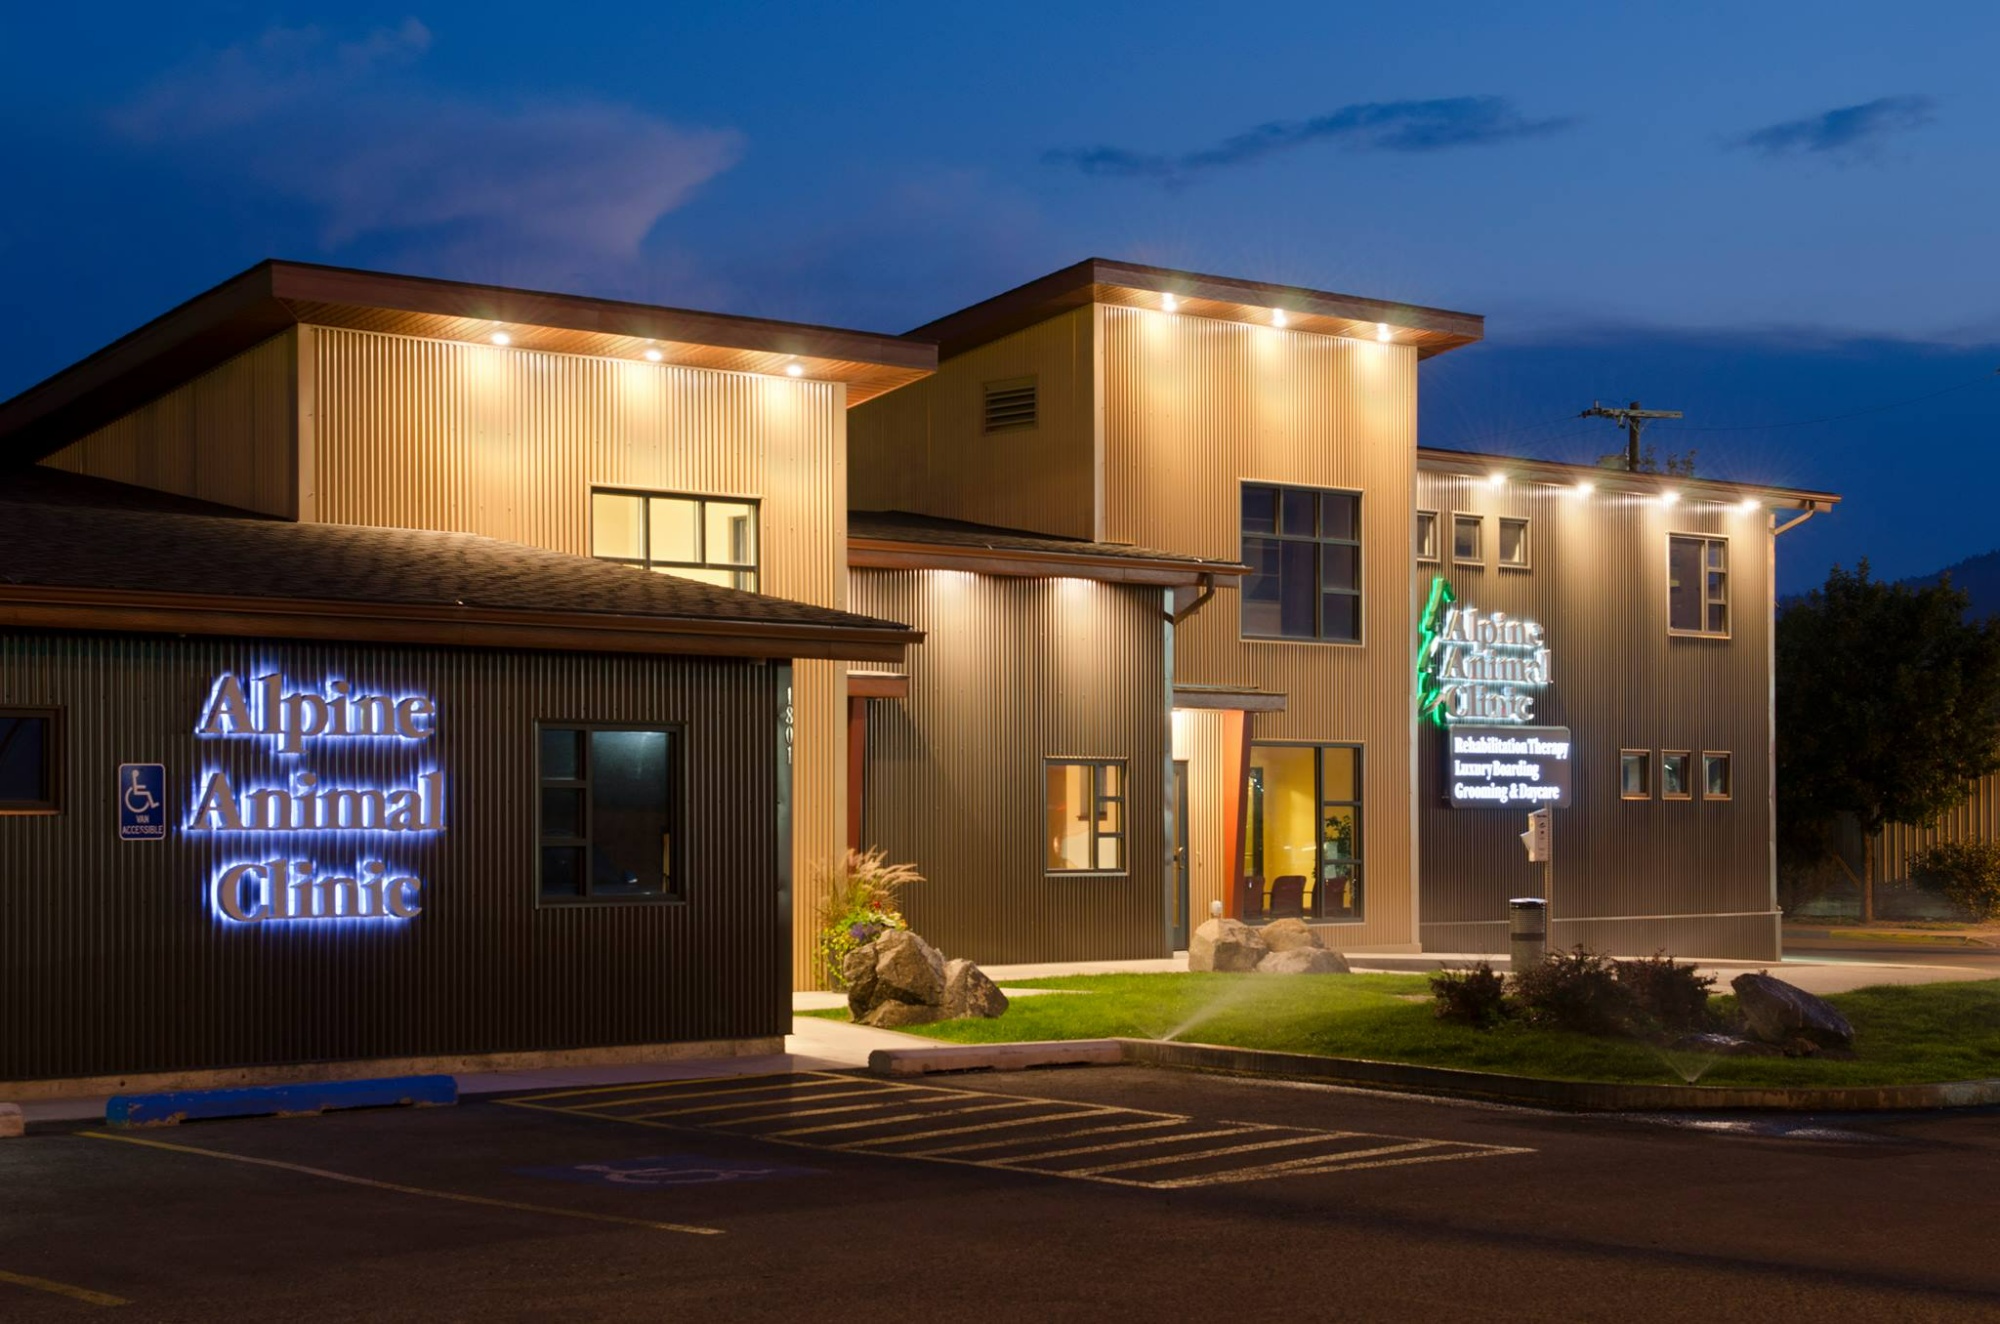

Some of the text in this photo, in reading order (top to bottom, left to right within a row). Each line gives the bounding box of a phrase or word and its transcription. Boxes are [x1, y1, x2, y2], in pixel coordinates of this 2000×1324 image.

[1441, 608, 1544, 653] Alpine
[1440, 646, 1553, 684] Animal
[196, 672, 436, 754] Alpine
[1444, 684, 1535, 720] Clinic
[785, 686, 794, 765] 1801
[1454, 736, 1570, 759] Rehabilitation Therapy
[1454, 760, 1539, 780] Luxury Boarding
[187, 770, 447, 832] Animal
[1454, 782, 1560, 803] Grooming & Daycare
[122, 825, 164, 834] ACCESSIBLE
[136, 814, 150, 823] VAN
[216, 858, 422, 923] Clinic
